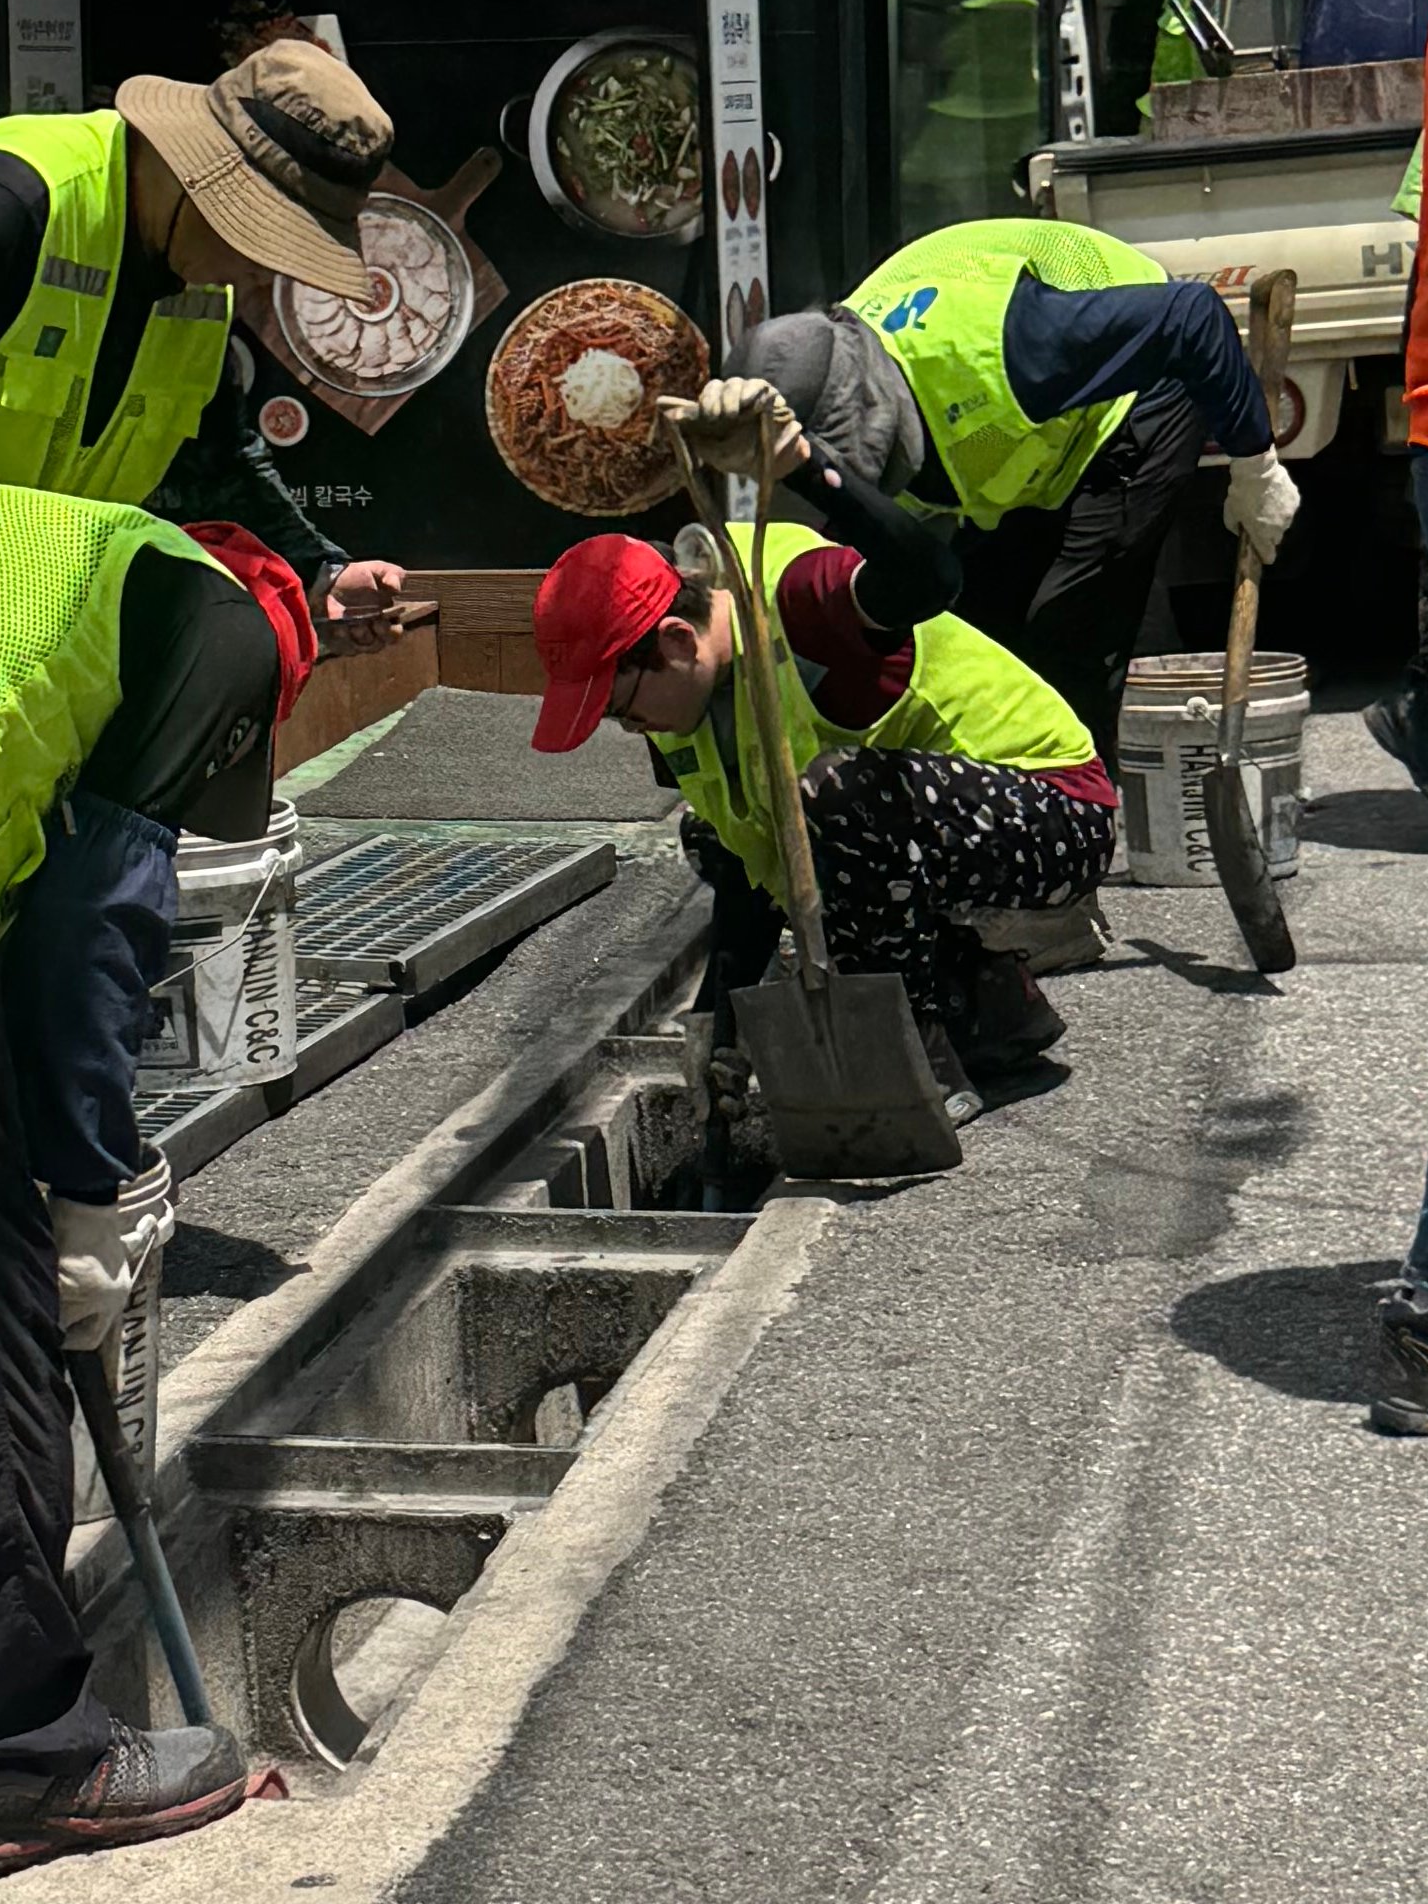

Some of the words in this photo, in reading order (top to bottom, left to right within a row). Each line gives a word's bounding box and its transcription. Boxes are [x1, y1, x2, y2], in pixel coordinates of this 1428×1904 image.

[1362, 241, 1418, 279] H
[315, 485, 373, 508] 칼국수
[244, 1008, 281, 1065] C&C
